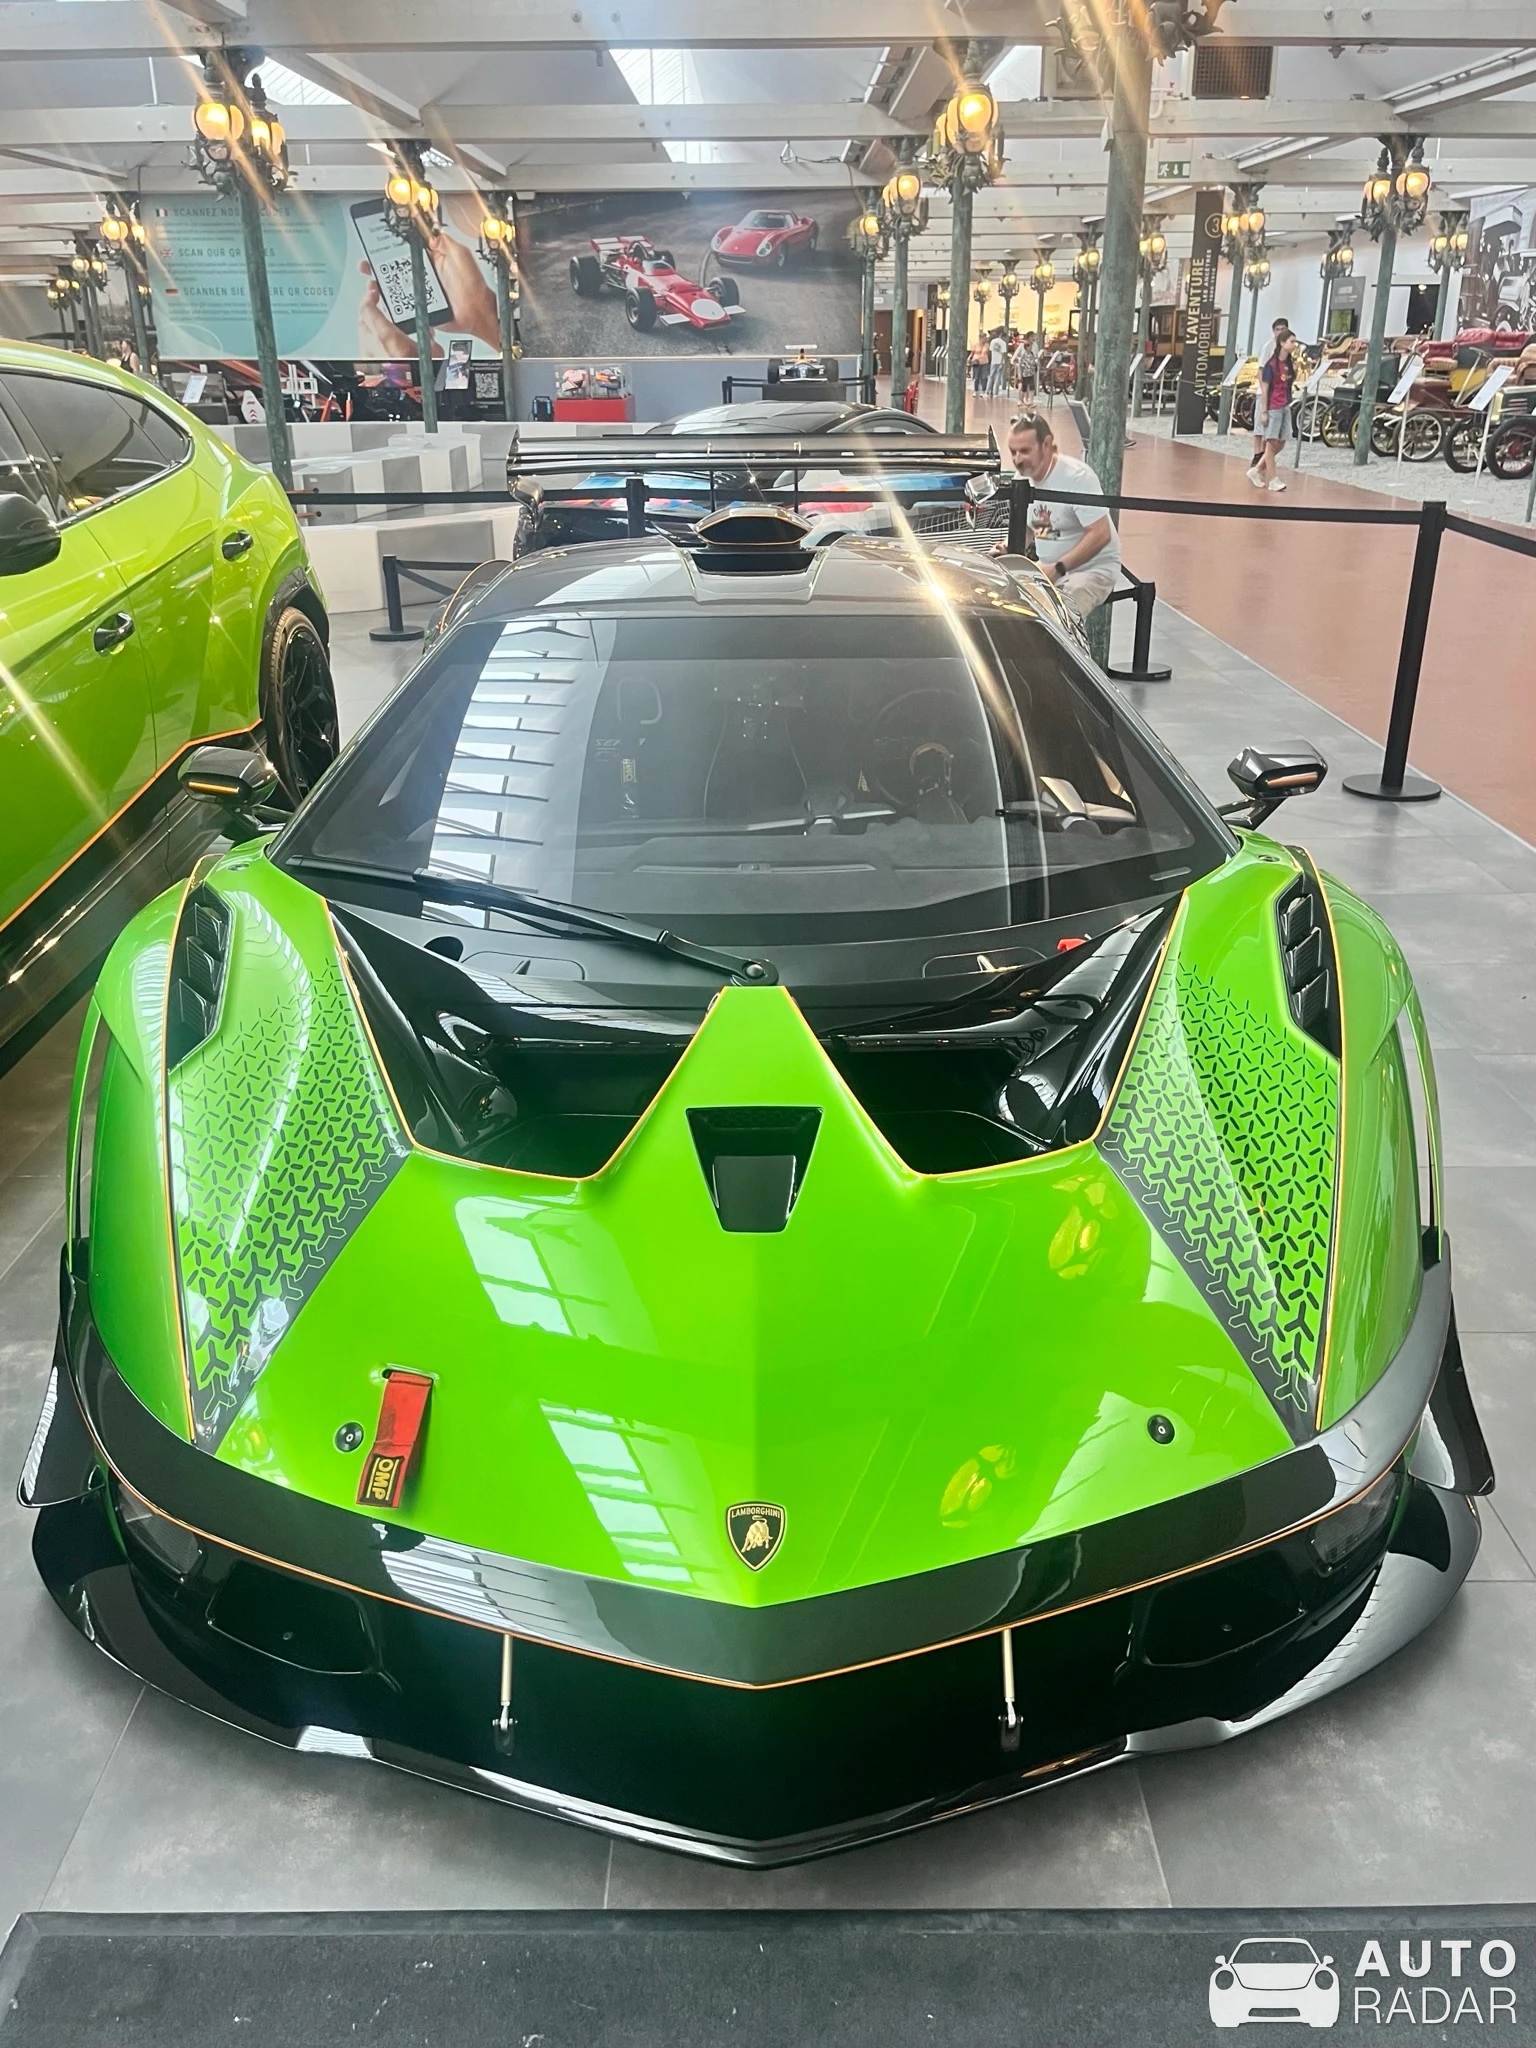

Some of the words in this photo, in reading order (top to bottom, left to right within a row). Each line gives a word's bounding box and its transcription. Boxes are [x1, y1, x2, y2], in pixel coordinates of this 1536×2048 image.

[174, 207, 217, 217] SCANNEZ
[1211, 217, 1220, 233] 3
[178, 248, 203, 257] SCAN
[207, 248, 225, 257] OUR
[228, 248, 240, 258] QR
[183, 287, 228, 296] SCANNEN
[230, 287, 245, 296] SIE
[288, 287, 300, 297] QR
[303, 287, 334, 297] CODES
[1185, 258, 1204, 344] L'AVENTURE
[1194, 313, 1212, 397] AUTOMOBILE
[372, 1459, 394, 1500] OMP
[731, 1507, 781, 1519] LAMBORGHINI
